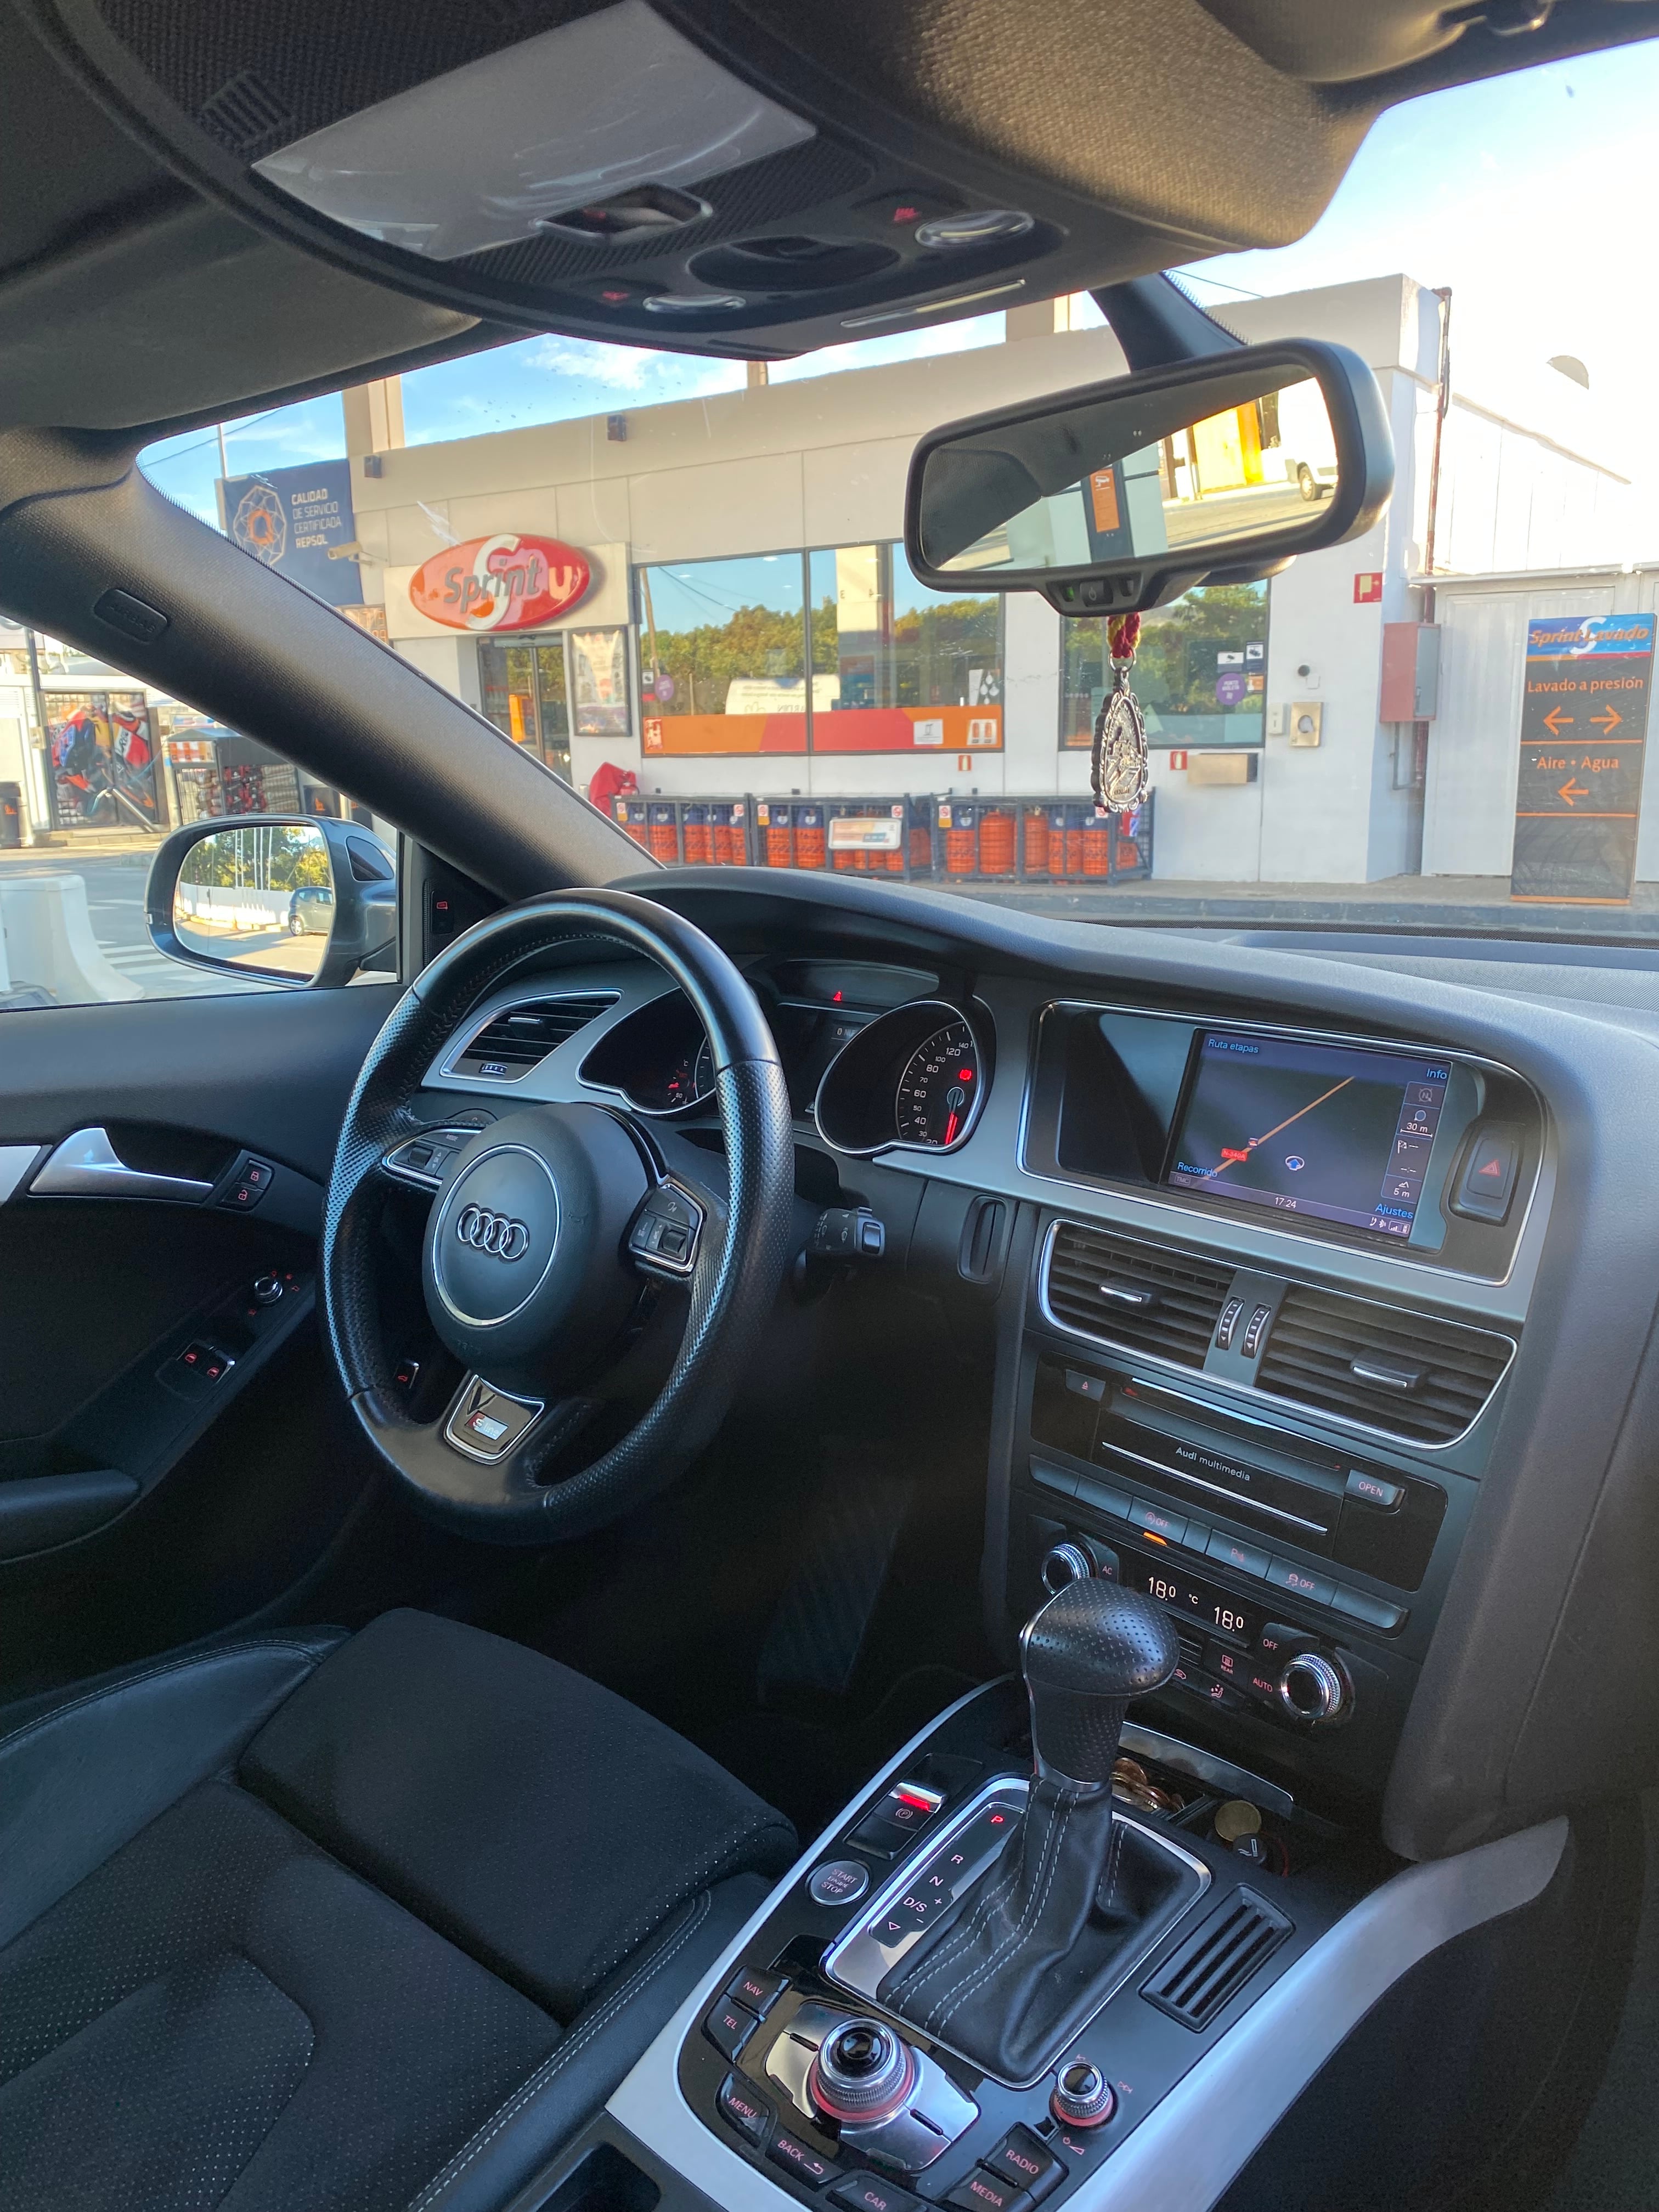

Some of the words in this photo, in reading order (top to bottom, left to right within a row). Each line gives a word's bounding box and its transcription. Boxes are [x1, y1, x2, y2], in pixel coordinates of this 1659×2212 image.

[291, 488, 328, 505] CALIDAD
[292, 507, 303, 520] DE
[304, 501, 338, 517] SERVICIO
[294, 516, 341, 534] CERTIFICADA
[295, 534, 328, 548] REPSOL
[443, 553, 543, 614] Sprint
[1530, 628, 1583, 648] Sprint
[1585, 624, 1650, 642] Lavado
[1527, 678, 1577, 693] Lavado
[1579, 680, 1588, 691] a
[1537, 756, 1566, 769] Aire
[1581, 755, 1620, 772] Agua
[945, 1047, 961, 1056] 120
[1208, 1038, 1228, 1048] Ruta
[1229, 1042, 1260, 1053] etapas
[926, 1064, 939, 1073] 80
[1426, 1068, 1448, 1079] Info
[913, 1090, 926, 1098] 60
[914, 1116, 927, 1125] 40
[1406, 1122, 1418, 1131] 30
[1223, 1149, 1246, 1160] N-340A
[1177, 1161, 1218, 1177] Recorrido
[1176, 1176, 1190, 1184] TMC
[1393, 1188, 1400, 1196] 5
[1274, 1197, 1297, 1209] 17:24
[1375, 1203, 1414, 1219] Ajustes
[1176, 1446, 1198, 1461] Audi
[1199, 1457, 1251, 1481] multimedia
[1358, 1481, 1384, 1497] OPEN
[1155, 1517, 1169, 1528] OFF
[1102, 1565, 1113, 1575] AC
[1299, 1579, 1316, 1590] OFF
[1263, 1638, 1279, 1651] OFF
[1221, 1664, 1234, 1675] REAR
[1252, 1677, 1273, 1693] AUTO
[990, 1815, 1004, 1824] P
[950, 1854, 964, 1865] R
[827, 1875, 849, 1889] ENGINE
[831, 1868, 859, 1884] START
[929, 1875, 944, 1887] N
[821, 1881, 844, 1894] STOP
[902, 1897, 928, 1912] D/S
[743, 1981, 764, 1996] NAV
[723, 2014, 738, 2030] TEL
[728, 2096, 759, 2119] MENU
[776, 2139, 806, 2162] BACK
[1005, 2149, 1040, 2175] RADIO
[864, 2191, 887, 2211] CAR
[969, 2180, 1003, 2208] MEDIA
